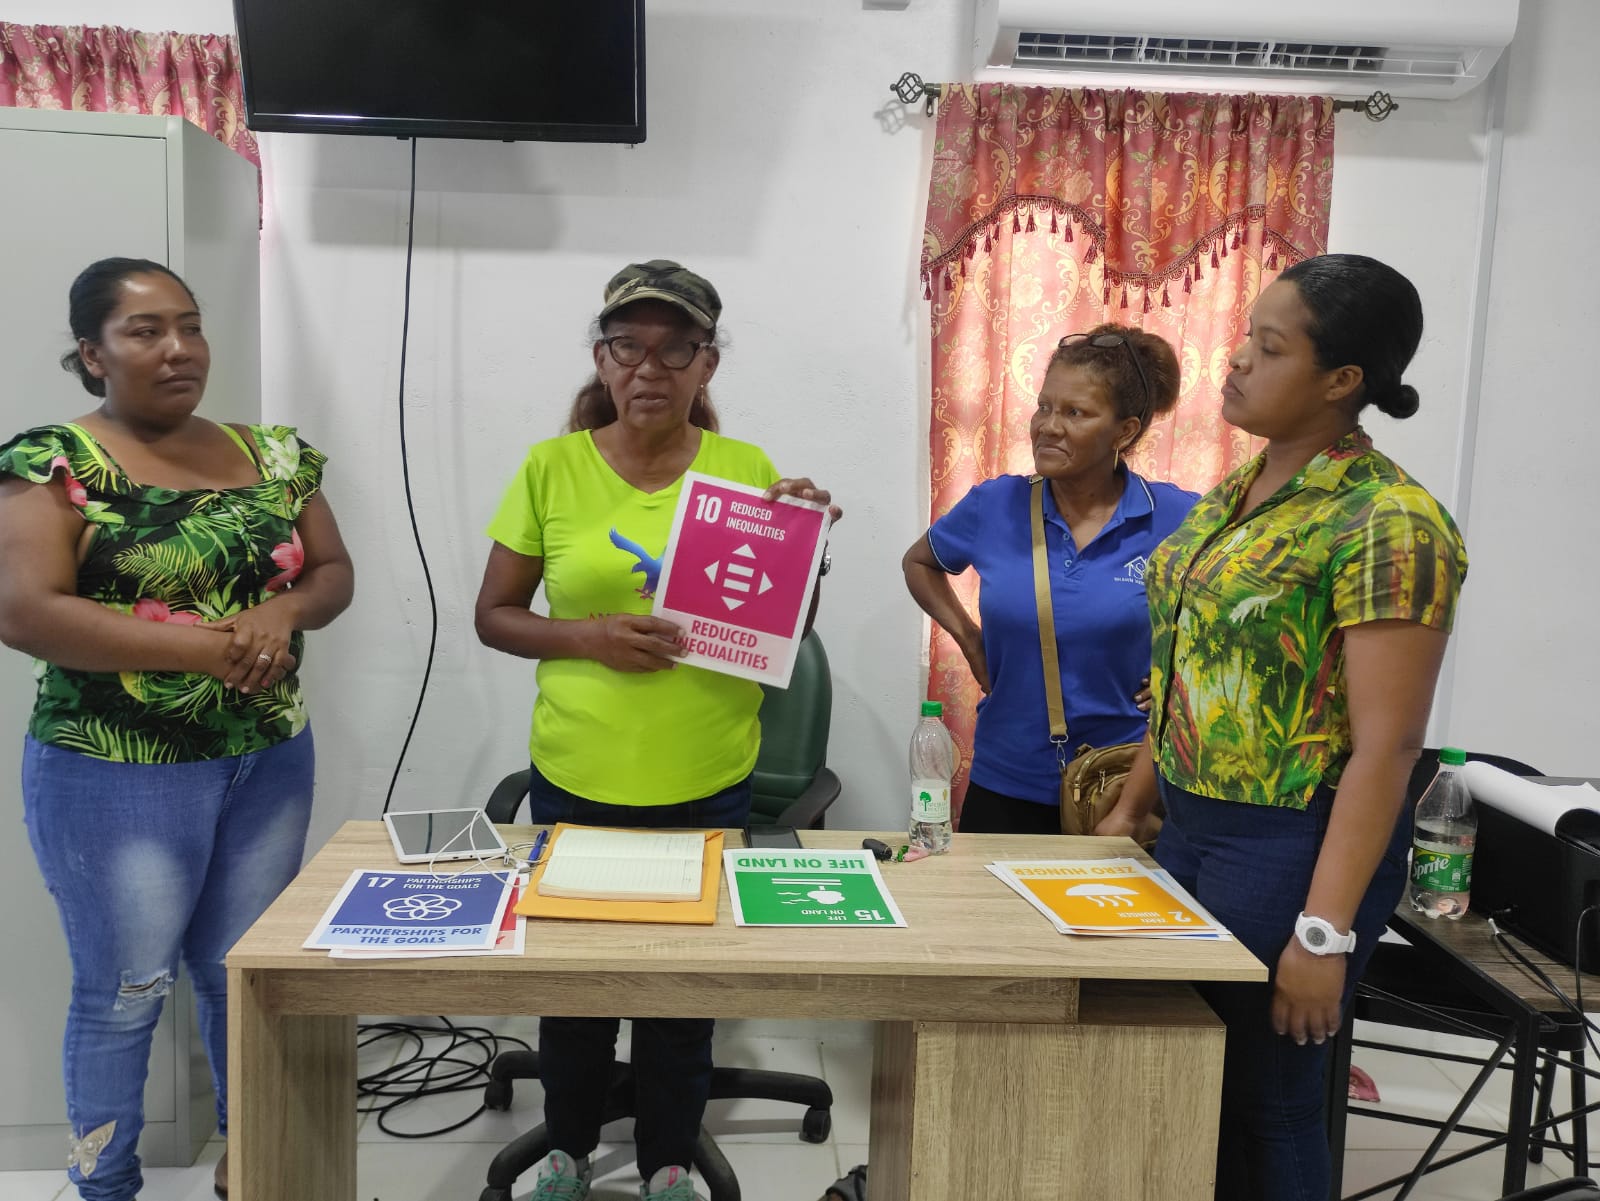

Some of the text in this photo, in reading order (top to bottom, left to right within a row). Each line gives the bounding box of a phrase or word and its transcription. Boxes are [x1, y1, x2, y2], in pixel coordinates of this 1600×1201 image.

[695, 493, 722, 525] 10
[729, 501, 773, 522] REDUCED
[726, 517, 786, 541] INEQUALITIES
[690, 619, 758, 649] REDUCED
[737, 858, 865, 868] LIFE ON LAND
[1412, 857, 1450, 880] Sprite
[1090, 866, 1136, 874] ZERO
[367, 877, 396, 888] 17
[854, 909, 887, 922] 15
[1168, 912, 1191, 922] 2
[331, 927, 483, 936] PARTNERSHIPS FOR
[360, 936, 446, 944] THE GOALS
